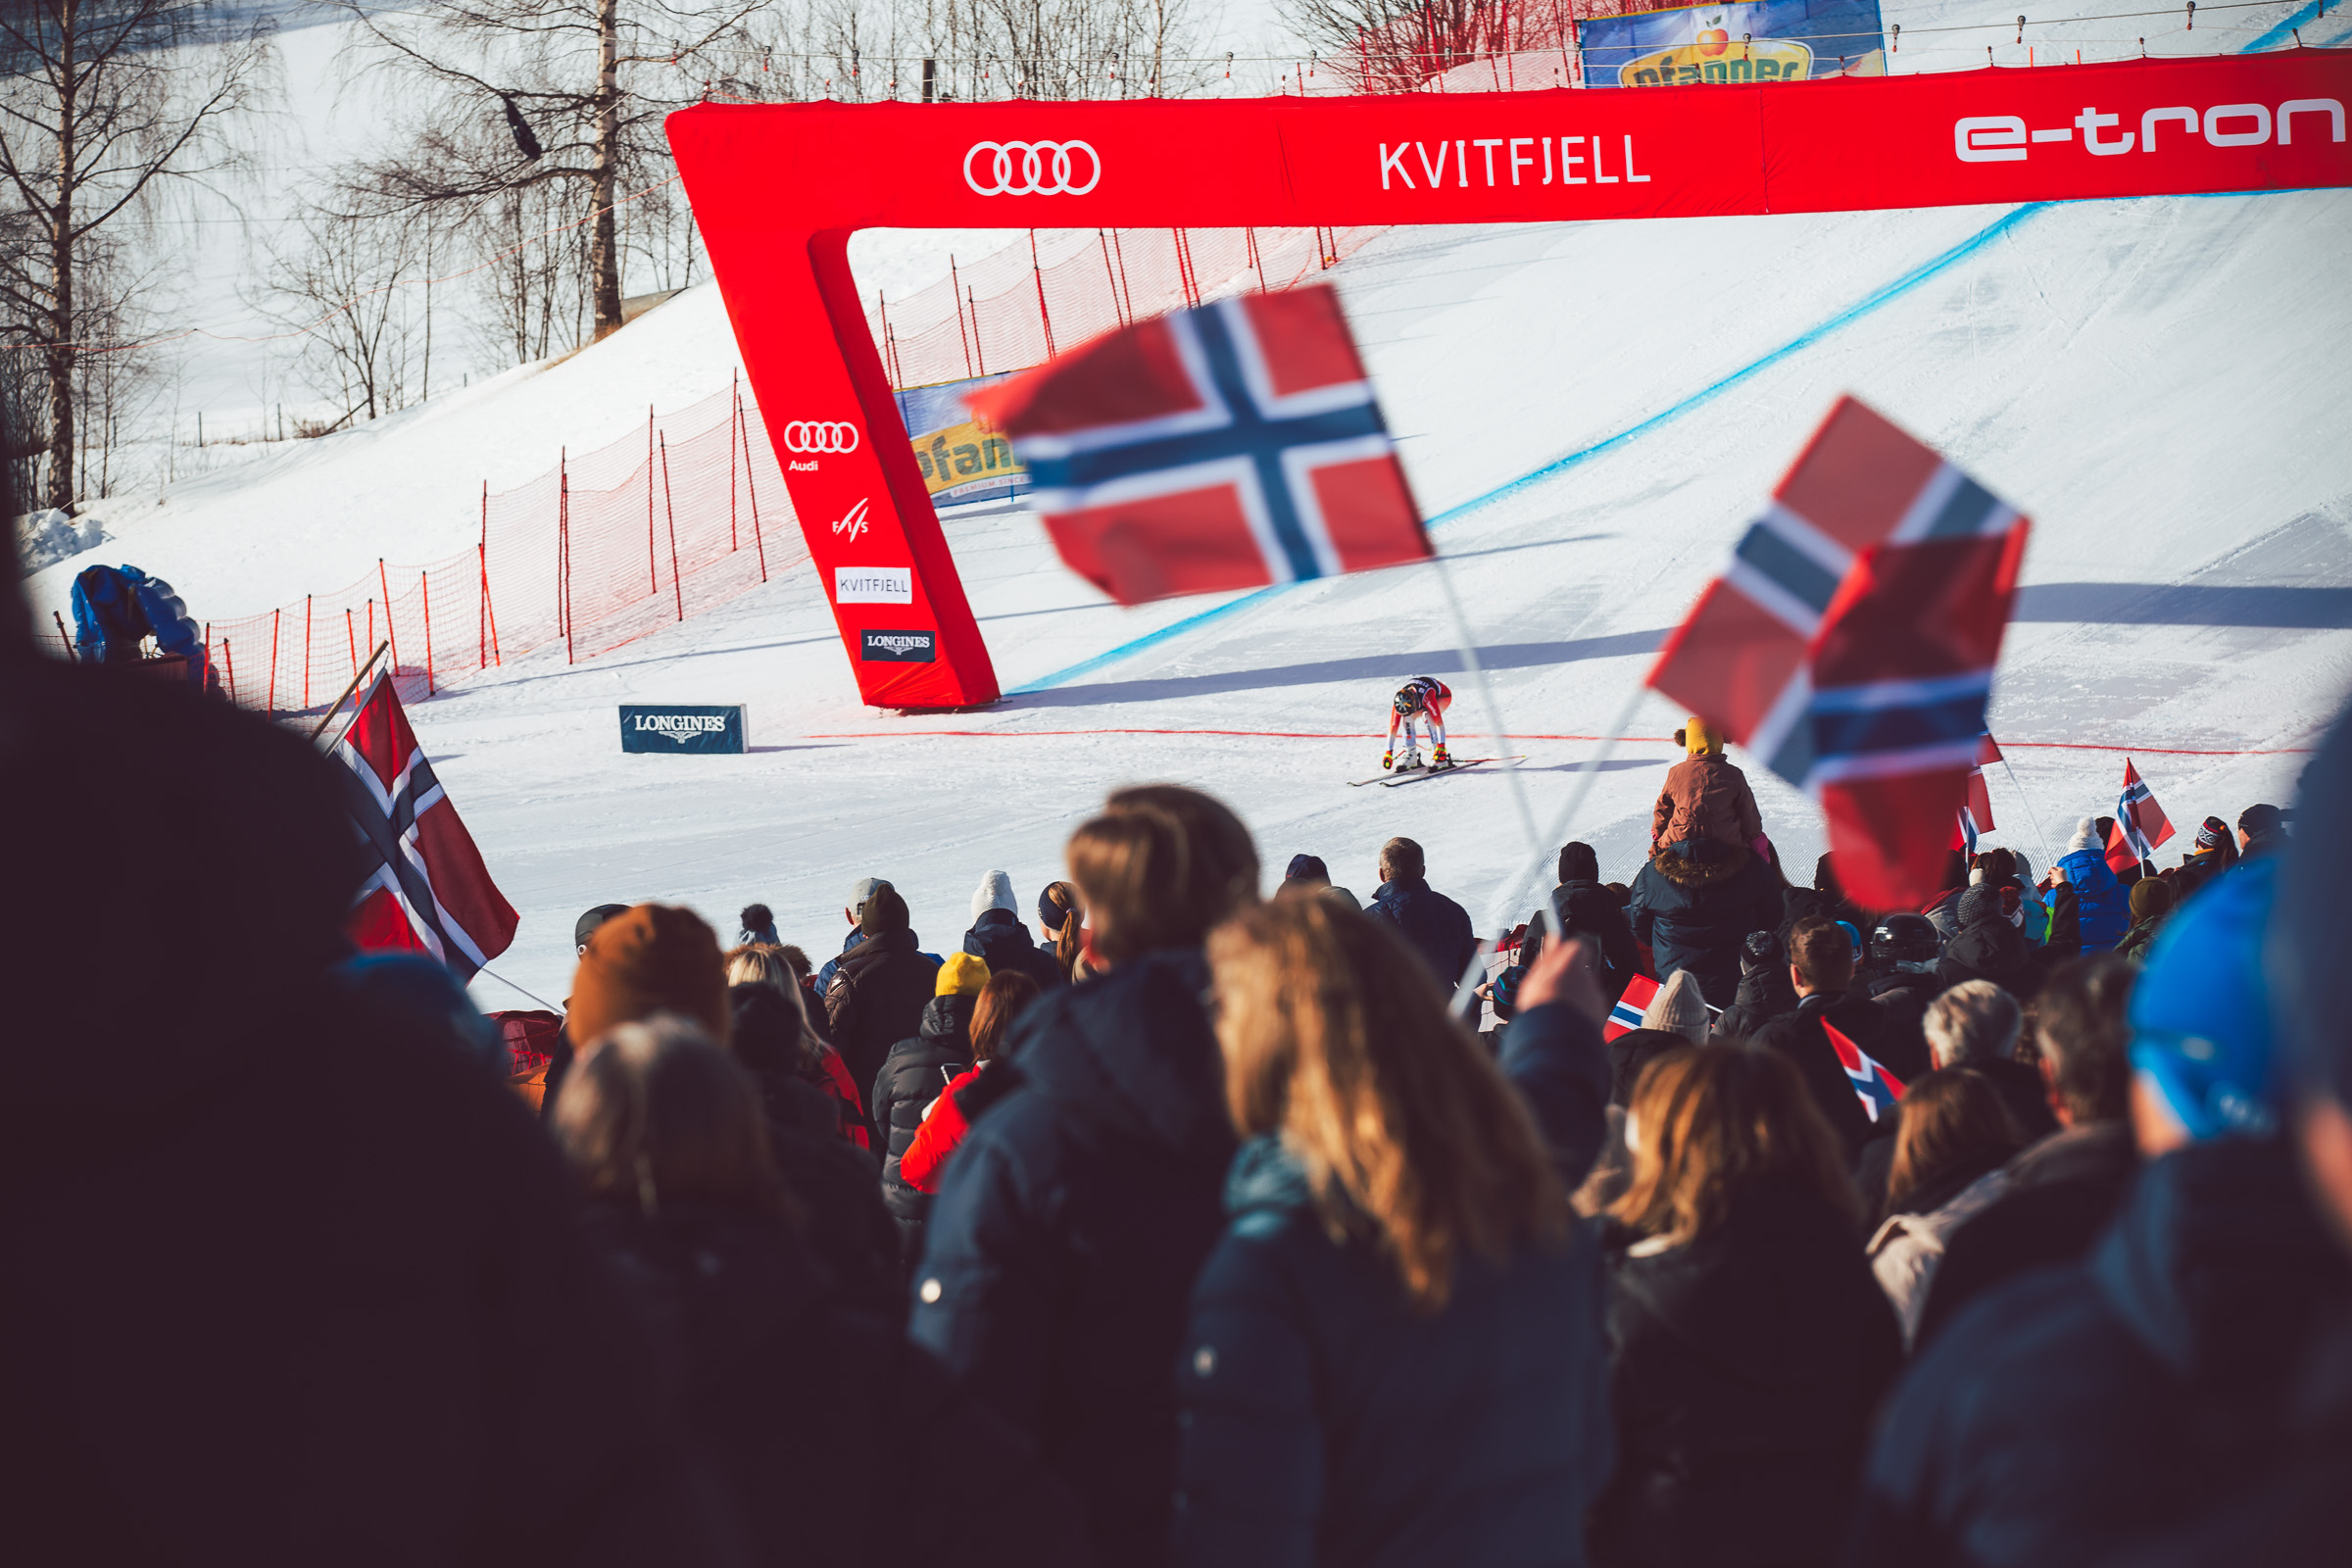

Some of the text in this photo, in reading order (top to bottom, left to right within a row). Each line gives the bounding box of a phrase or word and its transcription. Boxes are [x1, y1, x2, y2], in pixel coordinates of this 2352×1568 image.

[1954, 98, 2346, 163] e-tron
[1379, 134, 1651, 190] KVITFJELL
[789, 461, 818, 471] Audi
[954, 480, 996, 495] PREMIUM
[840, 578, 908, 593] KVITFJELL
[867, 635, 930, 648] LONGINES
[635, 714, 726, 732] LONGINES
